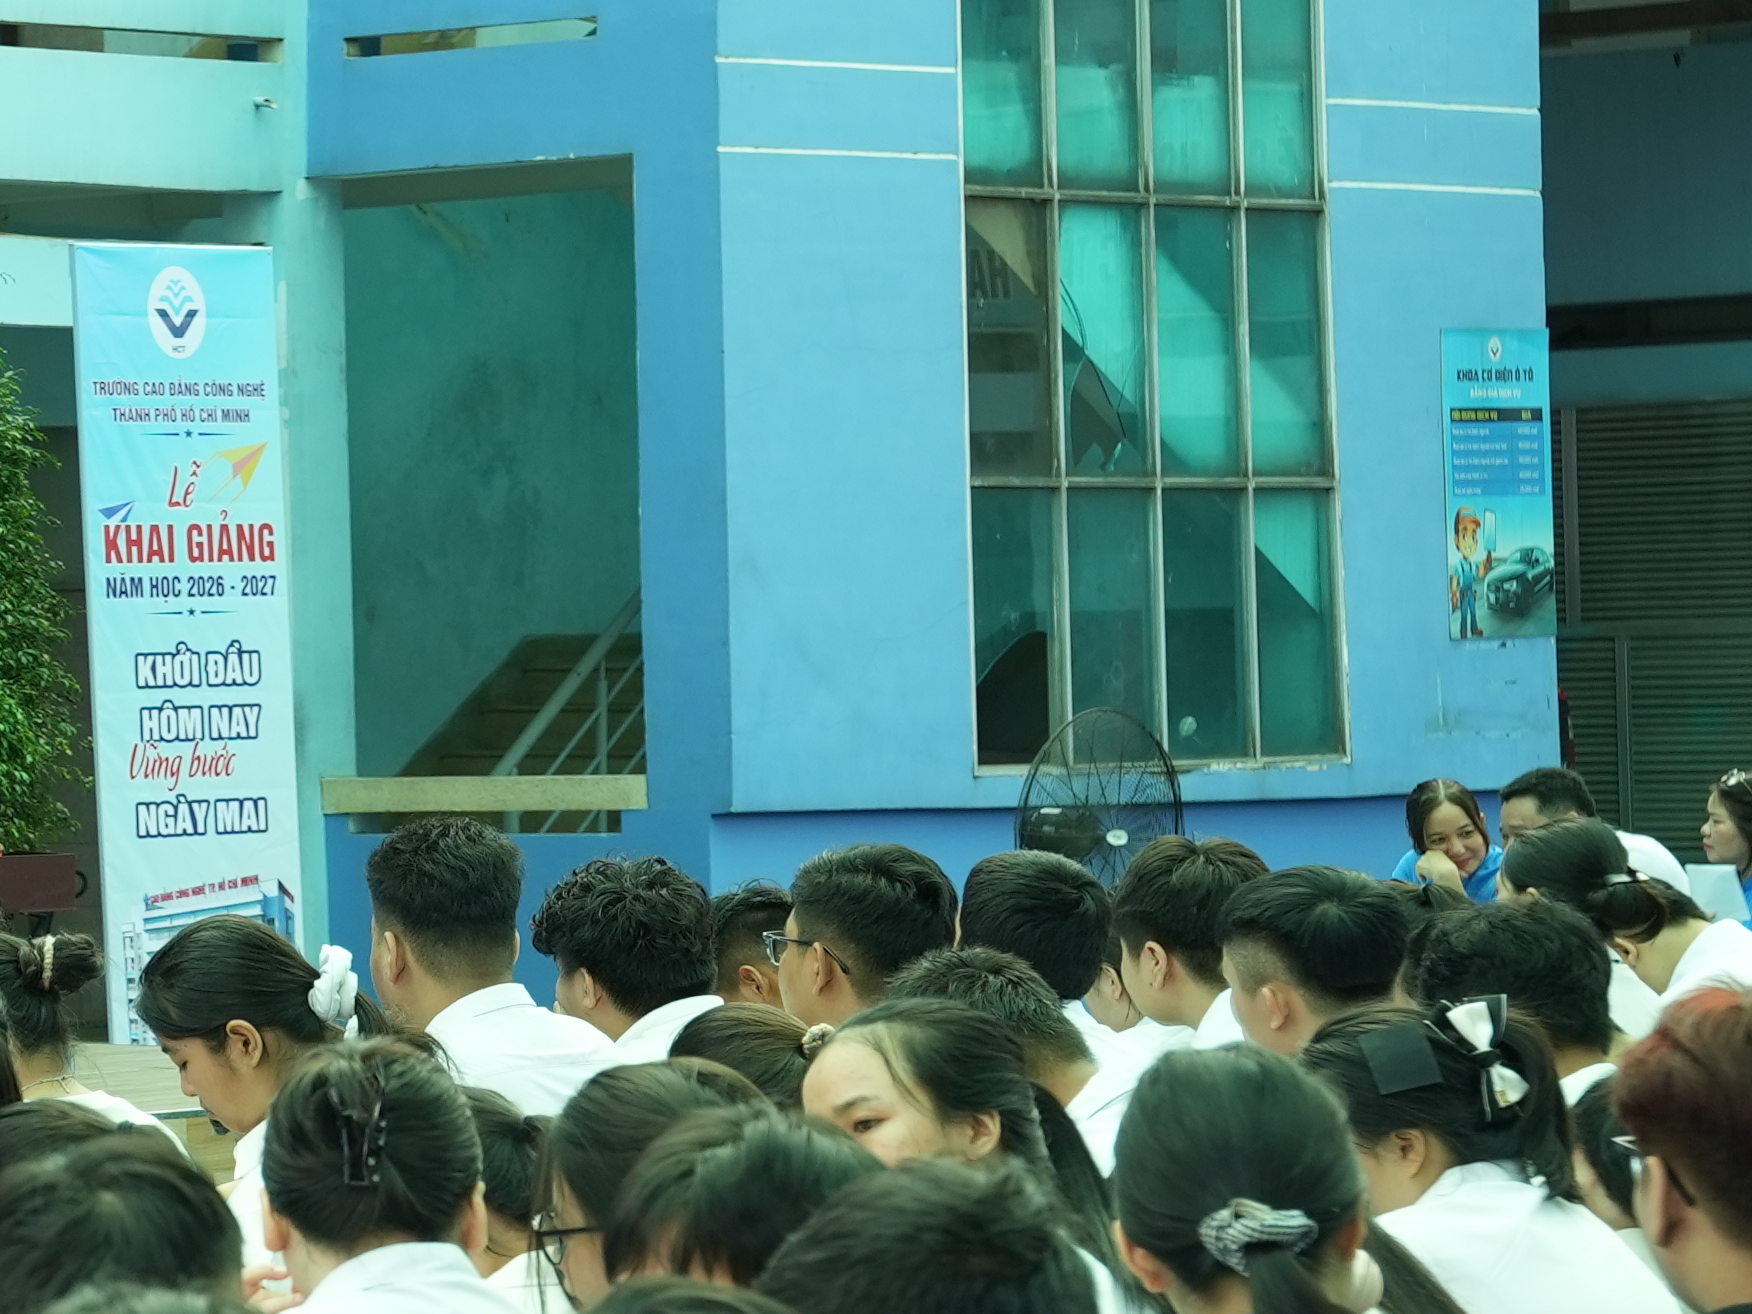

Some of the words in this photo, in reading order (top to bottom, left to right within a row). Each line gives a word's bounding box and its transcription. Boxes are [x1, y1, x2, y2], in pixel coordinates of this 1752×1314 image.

[92, 377, 140, 397] TRƯỜNG
[143, 381, 165, 397] CAO
[169, 375, 200, 397] ĐẲNG
[203, 380, 234, 397] CÔNG
[237, 380, 266, 401] NGHỆ
[1456, 368, 1479, 383] KHOA
[112, 404, 151, 423] THÀNH
[154, 402, 177, 423] PHỐ
[180, 403, 194, 423] HỒ
[199, 404, 218, 423] CHÍ
[221, 408, 251, 423] MINH
[167, 460, 202, 508] Lễ
[103, 523, 175, 564] KHAI
[186, 509, 276, 564] GIẢNG
[105, 572, 144, 599] NĂM
[149, 576, 181, 603] HỌC
[187, 575, 225, 597] 2026
[240, 575, 277, 597] 2027
[135, 641, 202, 688] KHỞI
[205, 640, 261, 686] ĐẦU
[140, 700, 204, 742] HÔM
[209, 704, 261, 741] NAY
[129, 742, 183, 792] Vững
[188, 740, 237, 778] bước
[136, 794, 210, 838] NGÀY
[215, 797, 268, 835] MAI
